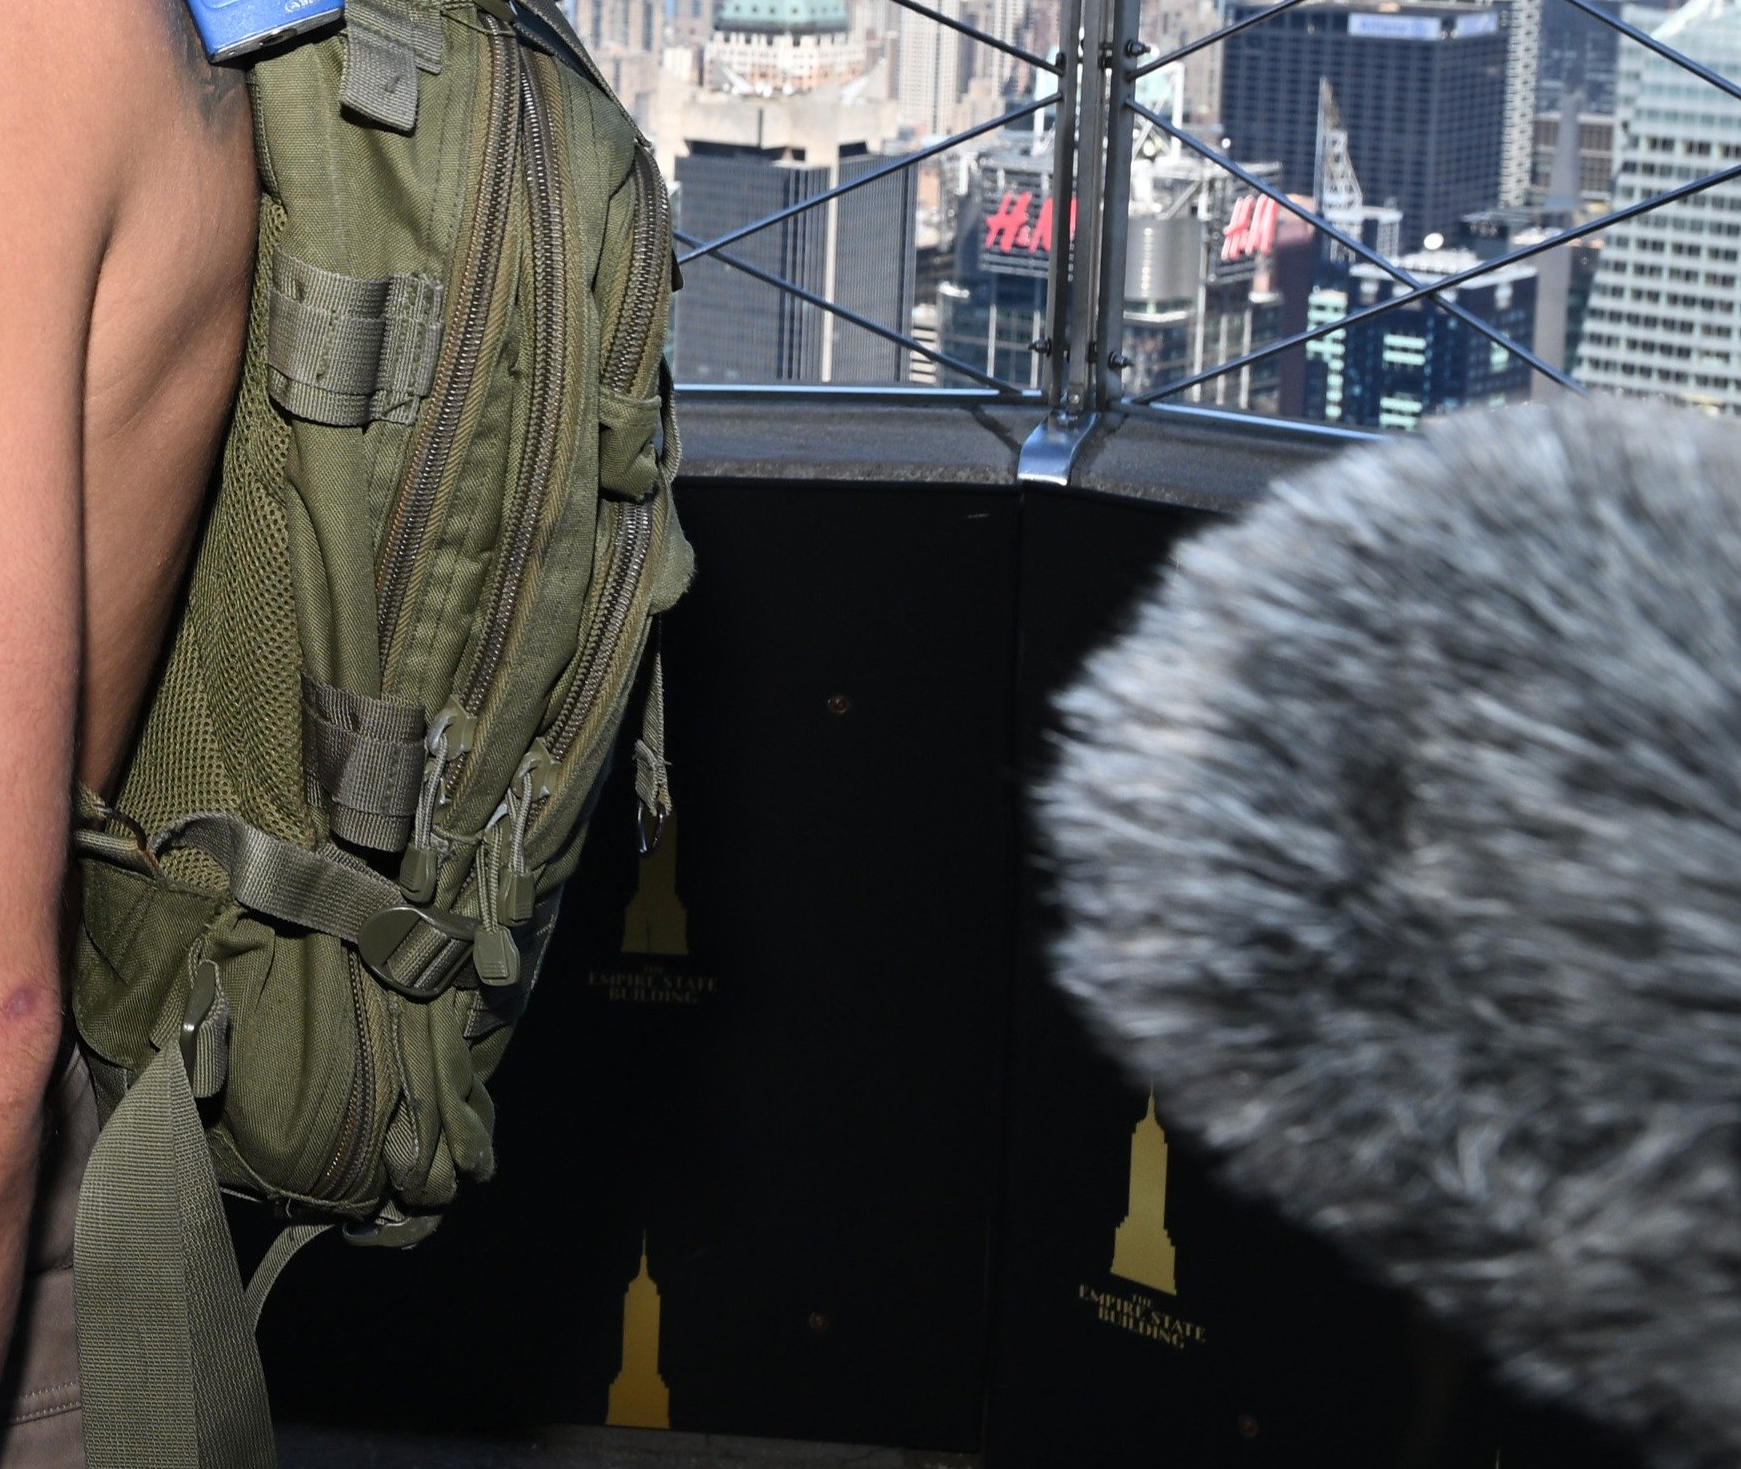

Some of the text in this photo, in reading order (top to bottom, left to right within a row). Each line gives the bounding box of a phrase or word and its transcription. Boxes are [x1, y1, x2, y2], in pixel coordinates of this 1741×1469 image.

[1079, 1283, 1207, 1344] EMPIRE STATE
[1098, 1305, 1185, 1350] BUILDING
